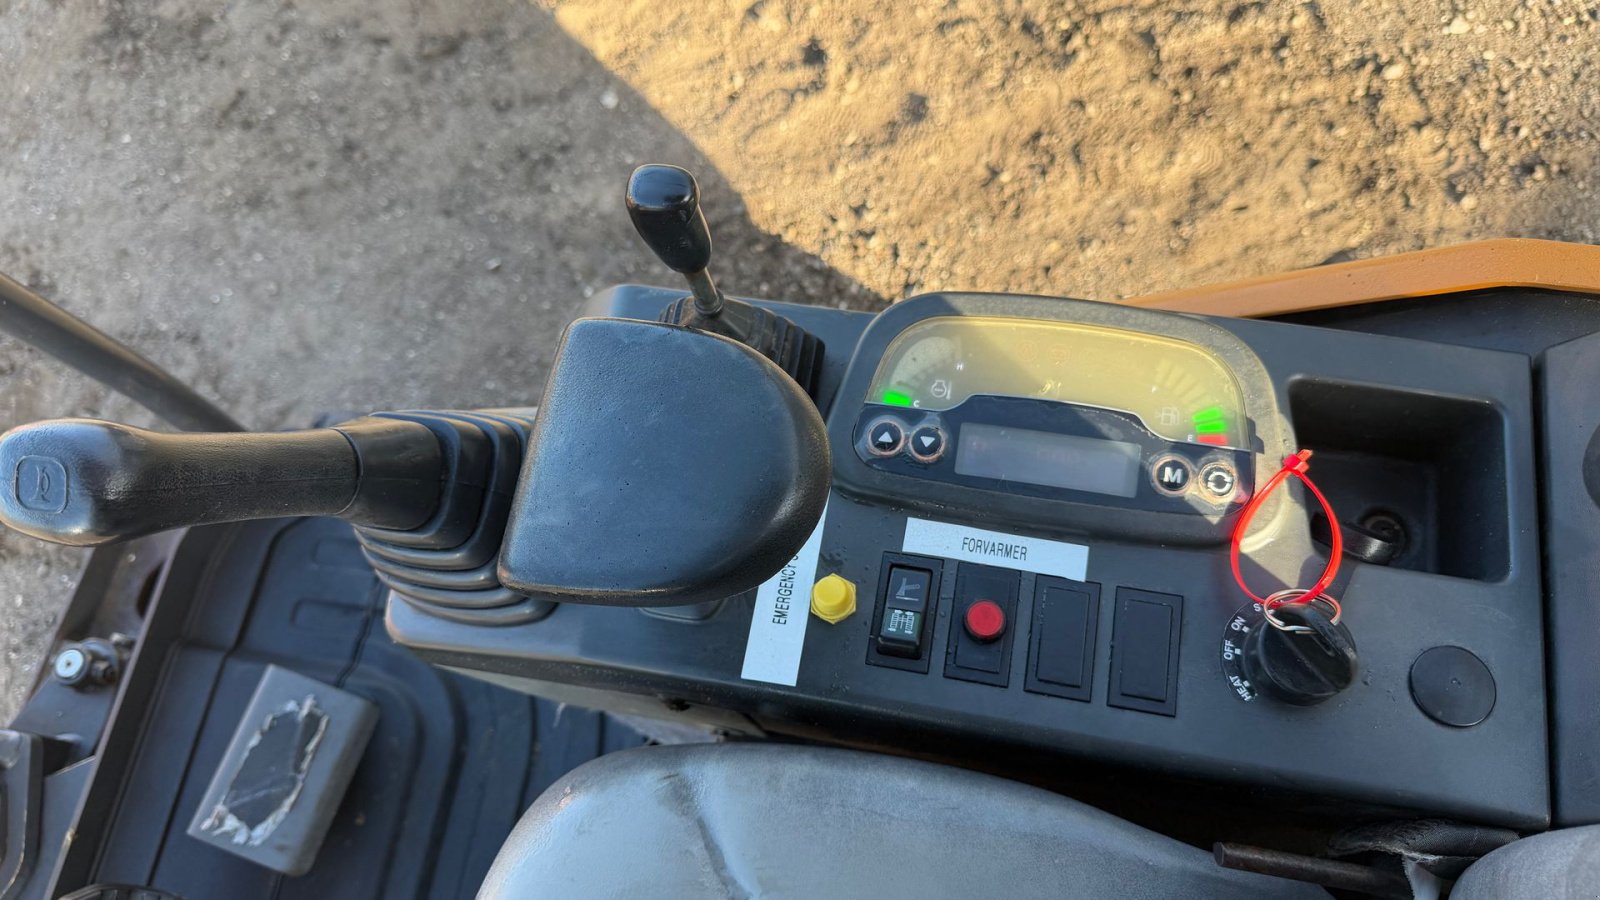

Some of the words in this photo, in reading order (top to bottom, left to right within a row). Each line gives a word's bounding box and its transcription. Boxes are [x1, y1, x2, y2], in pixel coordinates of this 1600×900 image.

[912, 399, 920, 408] C
[1162, 466, 1183, 484] M
[961, 536, 1028, 561] FORVARMER
[1231, 616, 1246, 631] ON
[1223, 640, 1234, 660] OFF
[1229, 675, 1252, 701] HEAT
